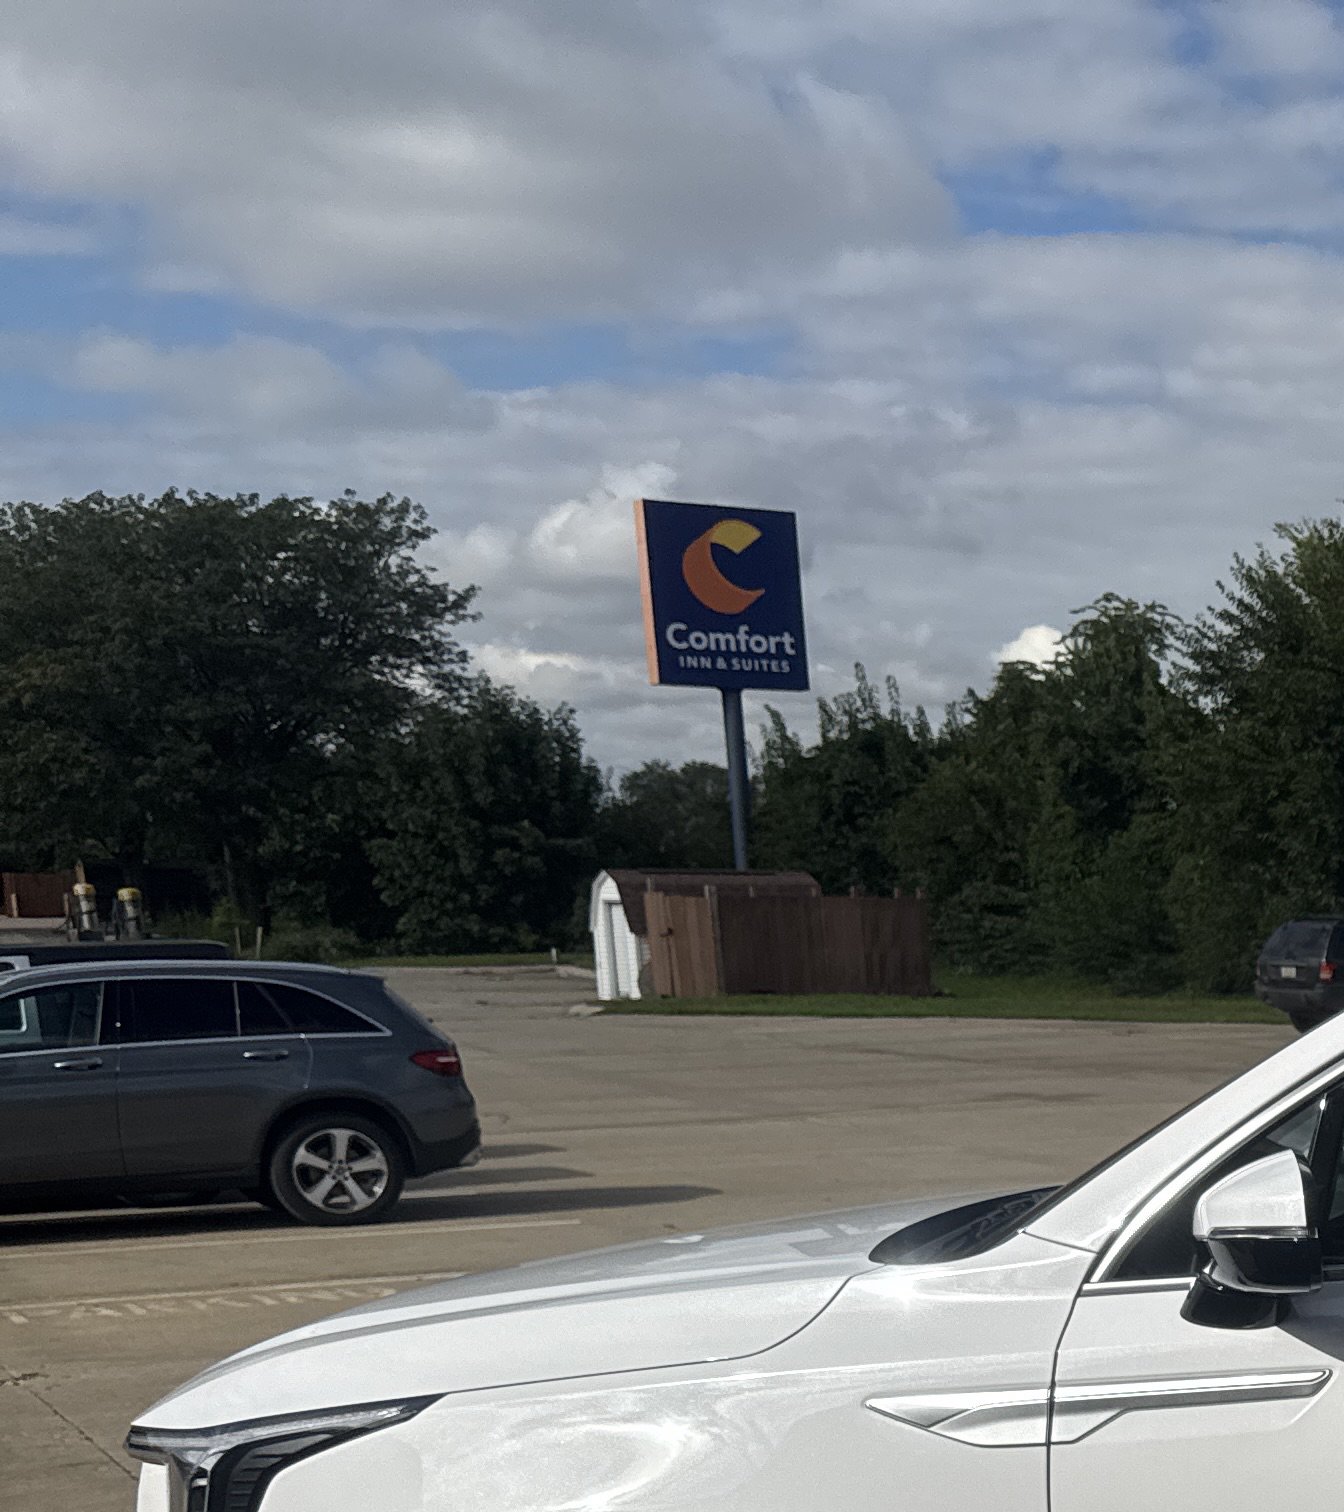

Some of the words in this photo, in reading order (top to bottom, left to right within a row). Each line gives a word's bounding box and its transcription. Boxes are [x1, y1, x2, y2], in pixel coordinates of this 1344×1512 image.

[666, 622, 796, 655] Comfort
[679, 655, 711, 669] INN
[716, 657, 728, 671] &
[731, 657, 791, 673] SUITES
